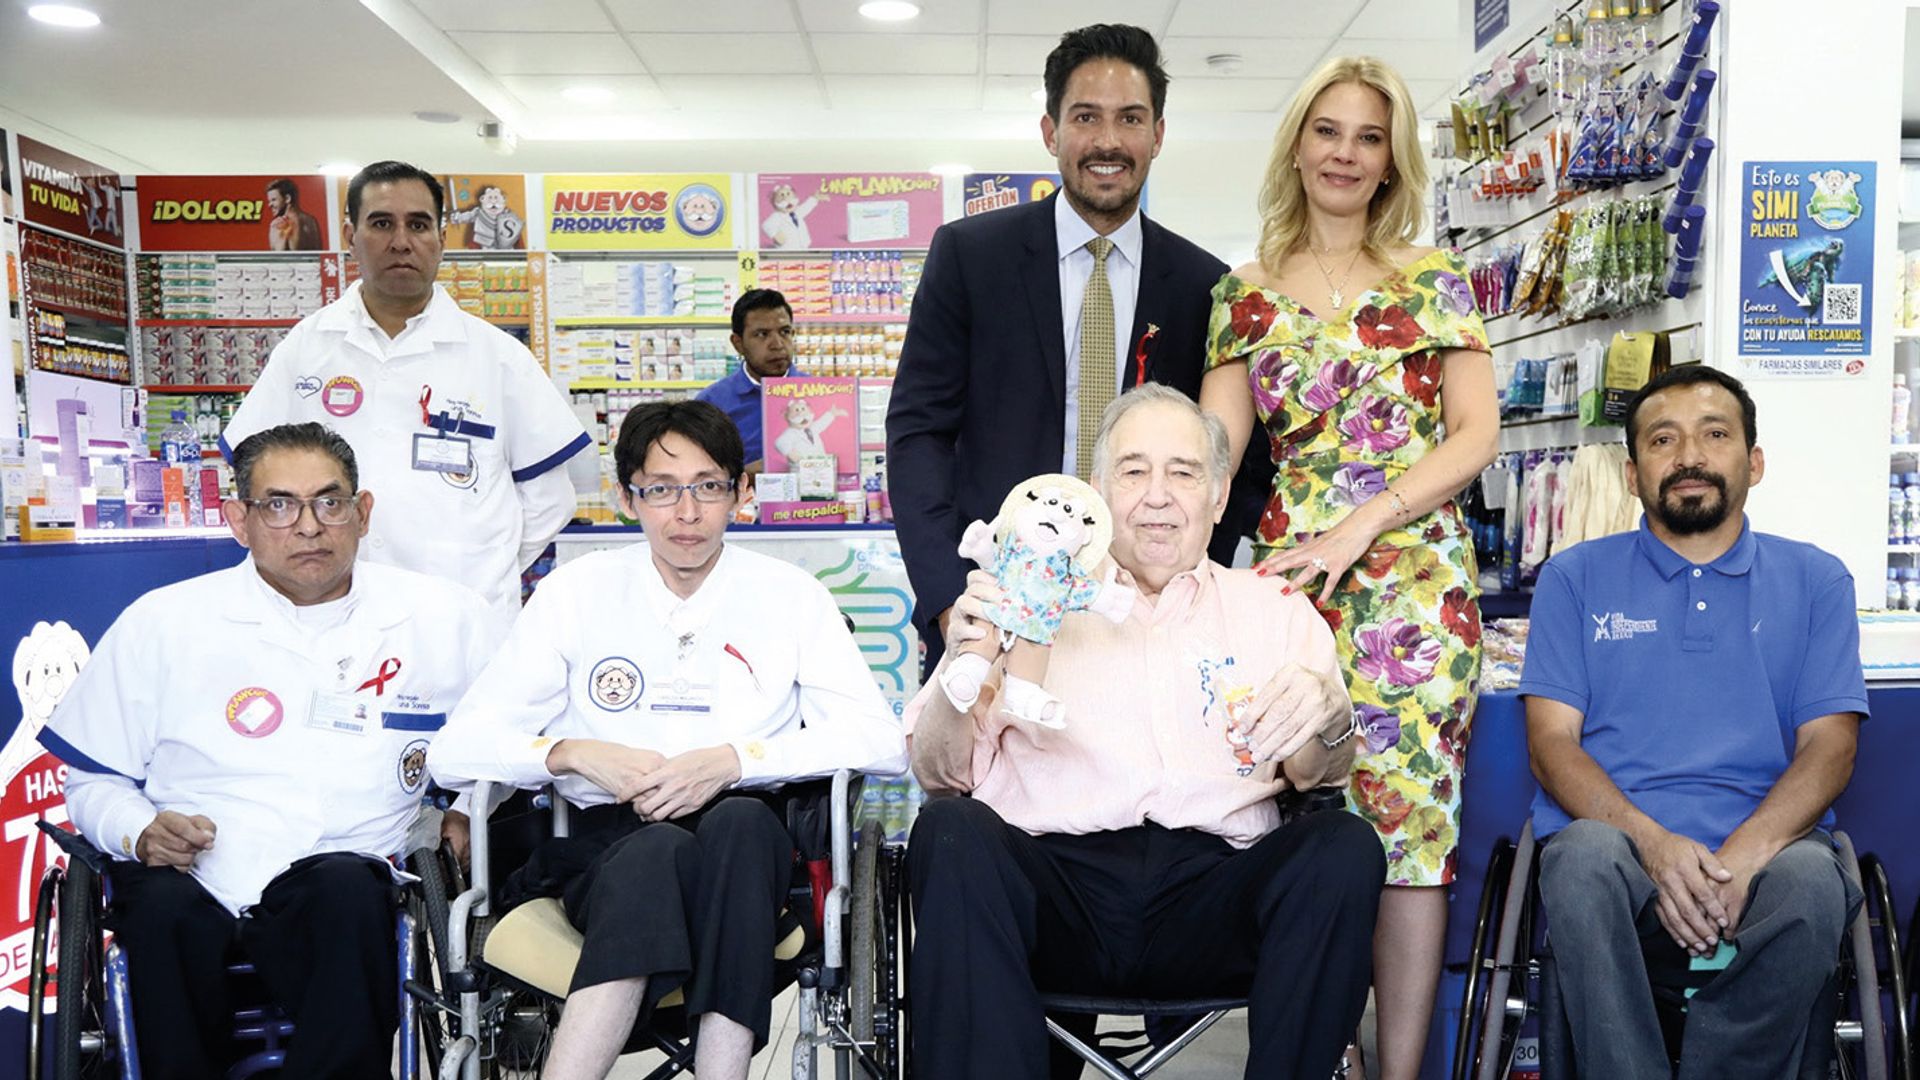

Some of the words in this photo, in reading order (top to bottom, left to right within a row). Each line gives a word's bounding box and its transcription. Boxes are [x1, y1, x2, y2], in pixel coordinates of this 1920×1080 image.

[22, 158, 84, 195] VITAMINA
[1752, 165, 1782, 189] Esto
[1784, 172, 1800, 185] es
[30, 183, 48, 205] TU
[51, 190, 80, 215] VIDA
[553, 191, 669, 213] NUEVOS
[152, 200, 264, 221] ¡DOLOR!
[550, 216, 667, 233] PRODUCTOS
[1750, 222, 1799, 238] PLANETA
[22, 260, 32, 292] VIDA
[26, 295, 34, 312] TU
[1743, 299, 1778, 313] Conoce
[533, 285, 544, 344] DEFENSAS
[29, 316, 39, 370] ITAMINA
[1743, 329, 1762, 341] CON
[1763, 329, 1776, 341] TU
[1777, 329, 1806, 341] AYUDA
[1758, 359, 1802, 371] FARMACIAS
[1803, 359, 1843, 371] SIMILARES
[773, 510, 790, 521] me
[25, 763, 69, 804] HAS
